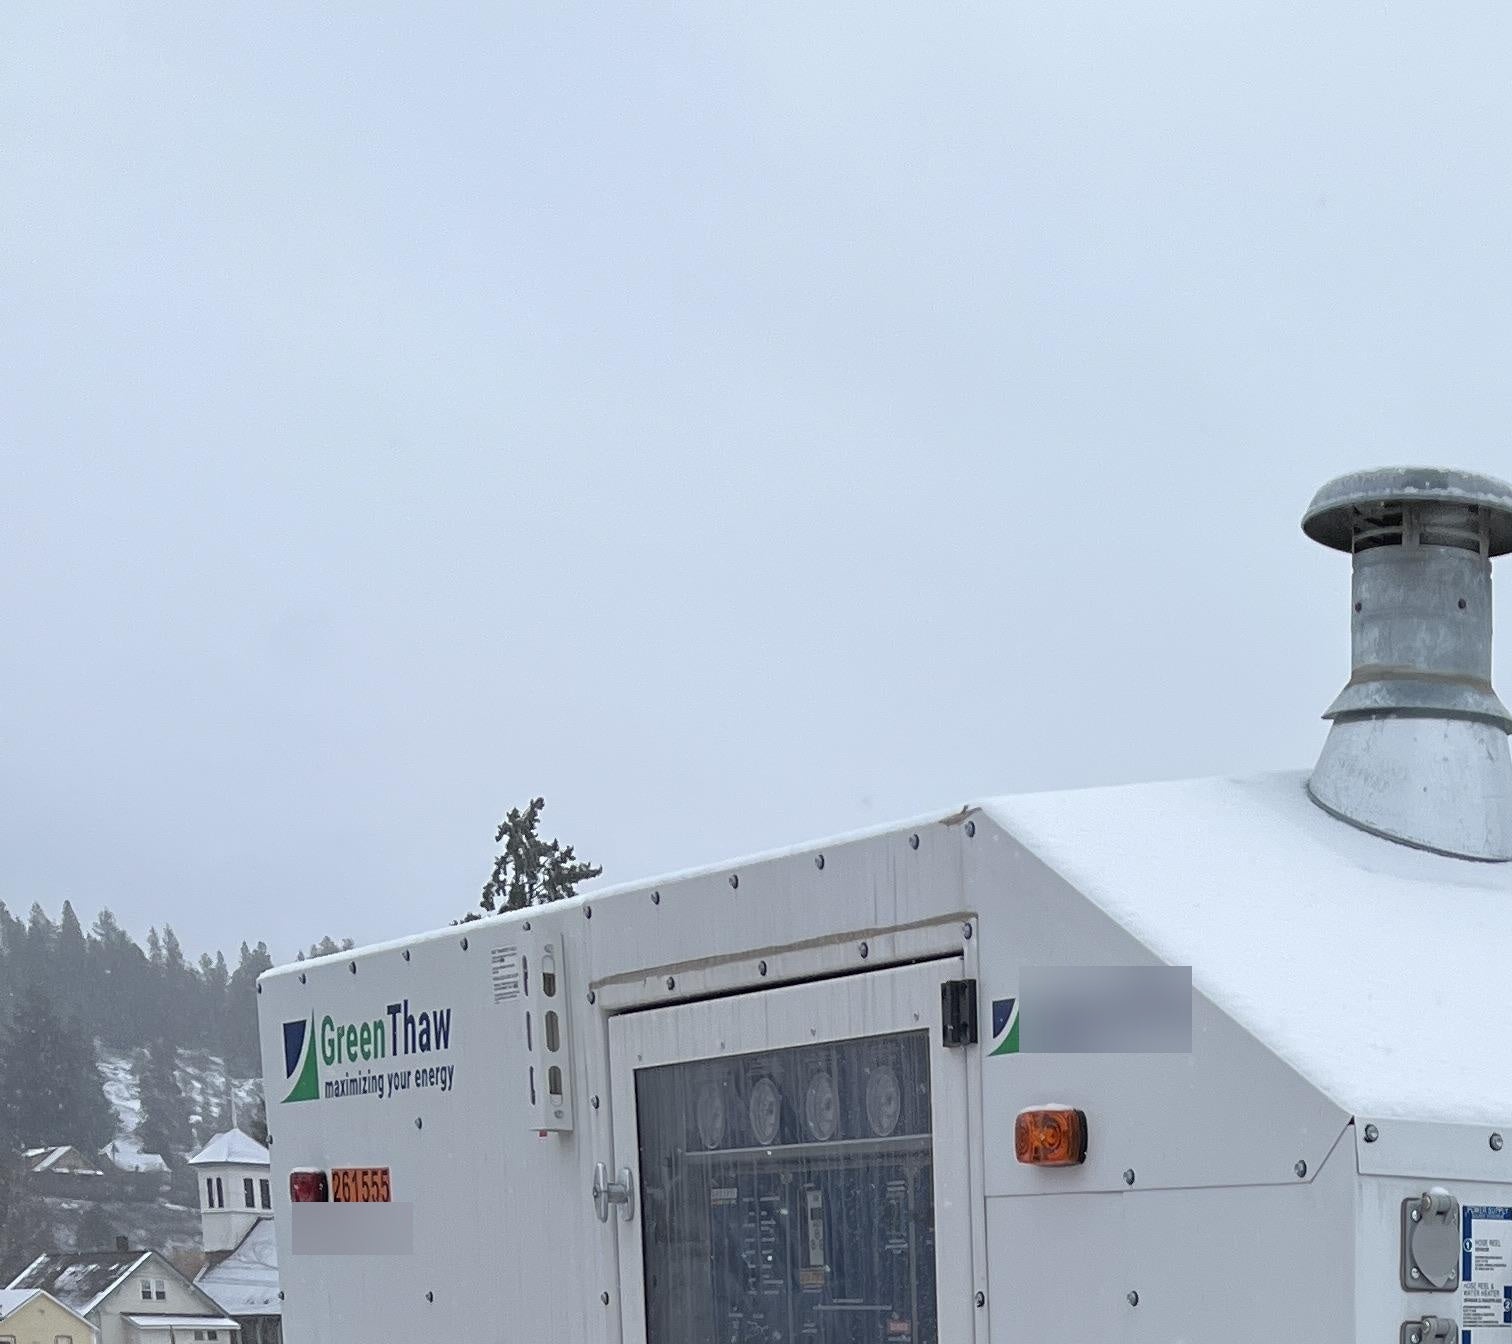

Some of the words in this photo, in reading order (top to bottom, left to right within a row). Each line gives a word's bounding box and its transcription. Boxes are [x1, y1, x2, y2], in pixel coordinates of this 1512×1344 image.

[321, 999, 451, 1066] GreenThaw
[325, 1069, 384, 1099] maximizing
[387, 1070, 411, 1098] your
[415, 1064, 455, 1092] energy
[332, 1170, 390, 1202] 261555
